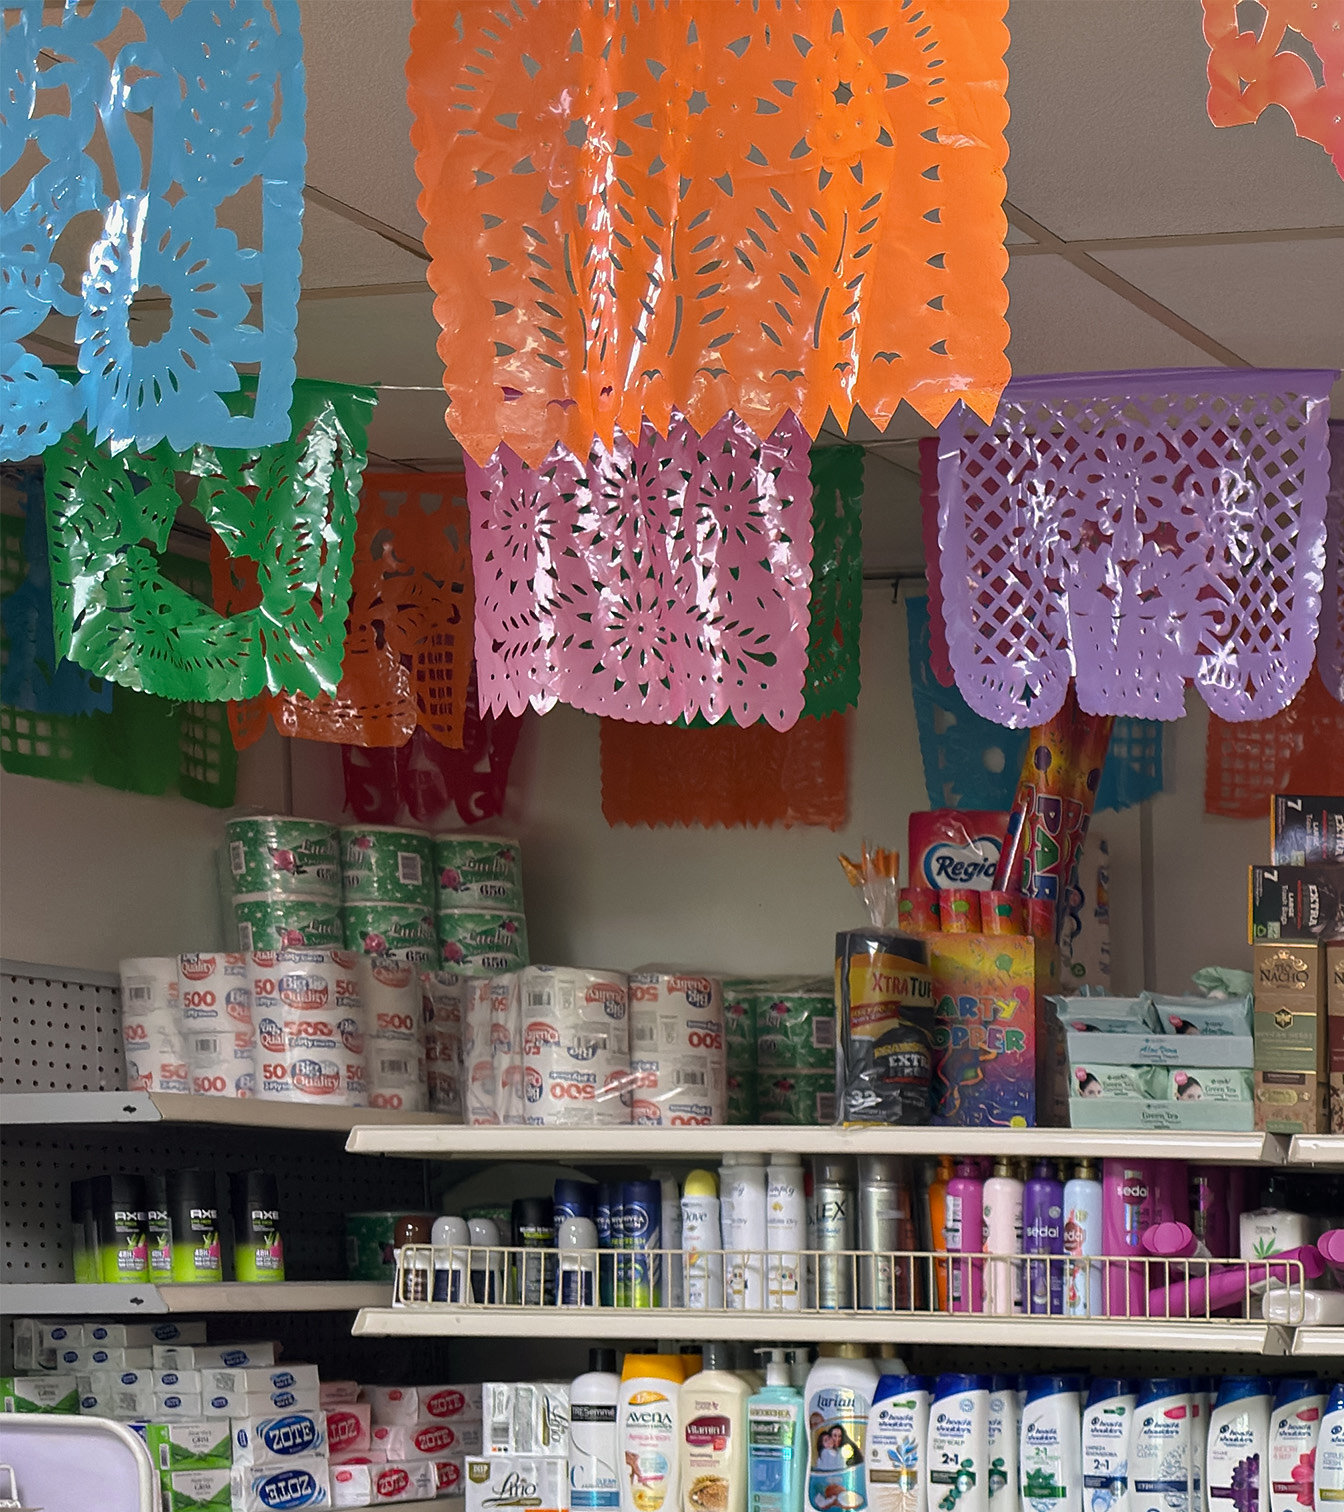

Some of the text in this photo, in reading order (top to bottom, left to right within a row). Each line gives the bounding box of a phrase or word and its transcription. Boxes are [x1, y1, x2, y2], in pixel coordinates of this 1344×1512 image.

[936, 856, 997, 883] Regio
[1260, 970, 1309, 983] NACHO
[184, 991, 216, 1007] 500
[281, 989, 328, 1004] Quality
[114, 1211, 145, 1221] AXE
[190, 1209, 218, 1219] AXE
[251, 1210, 279, 1221] AXE
[1026, 1224, 1059, 1239] sedal
[430, 1396, 465, 1411] ZOTE
[269, 1425, 315, 1450] ZOTE
[418, 1430, 451, 1447] ZOTE
[265, 1477, 312, 1503] ZOTE
